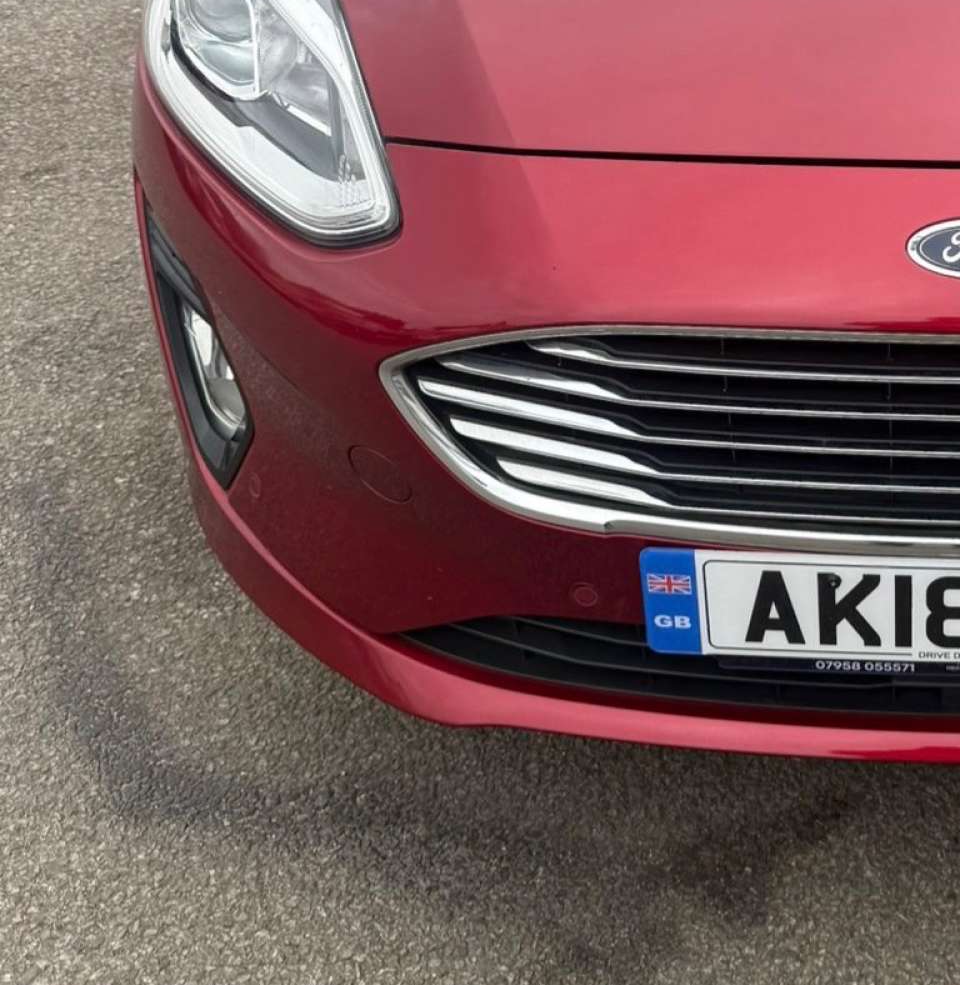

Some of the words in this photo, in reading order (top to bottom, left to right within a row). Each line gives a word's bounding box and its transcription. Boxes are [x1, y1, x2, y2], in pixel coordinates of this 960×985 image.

[653, 614, 692, 629] GB
[917, 651, 951, 660] DRIVE
[815, 660, 861, 671] 07958
[864, 661, 915, 672] 055571
